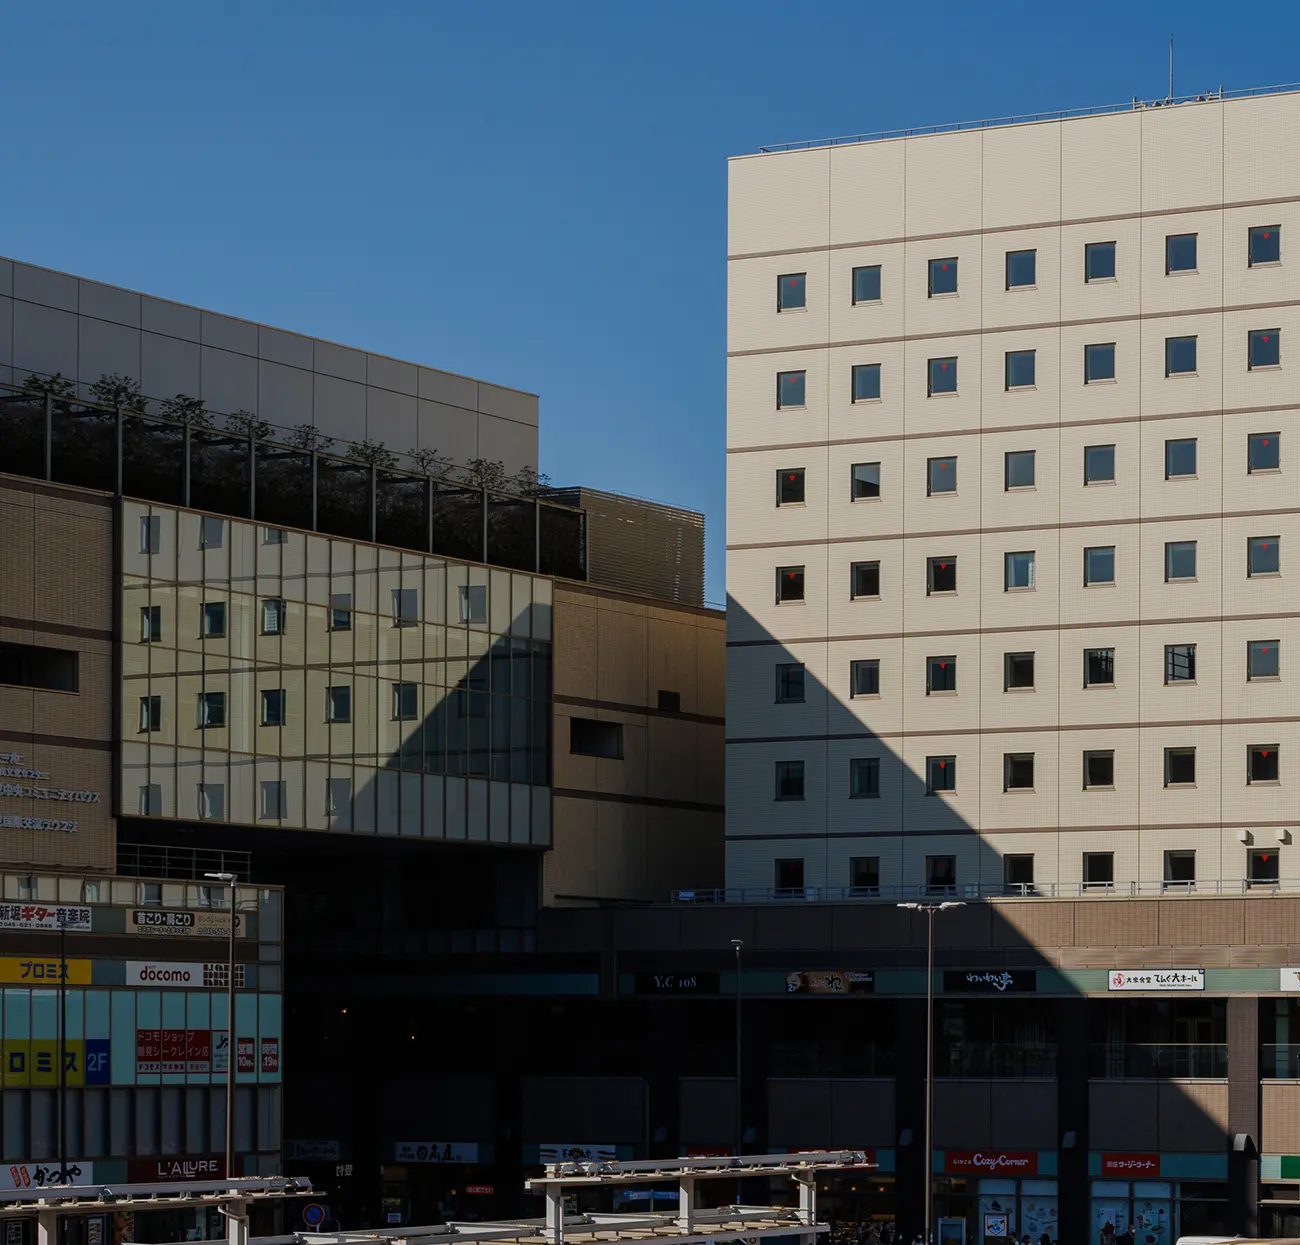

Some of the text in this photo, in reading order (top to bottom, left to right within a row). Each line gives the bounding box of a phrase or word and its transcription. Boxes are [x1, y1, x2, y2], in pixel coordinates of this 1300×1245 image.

[20, 960, 69, 979] プロミス
[140, 966, 190, 982] docomo
[138, 1031, 196, 1041] ドコモショップ
[87, 1052, 108, 1072] 2F
[33, 1164, 82, 1187] かつや
[157, 1160, 218, 1178] L'ALLURE
